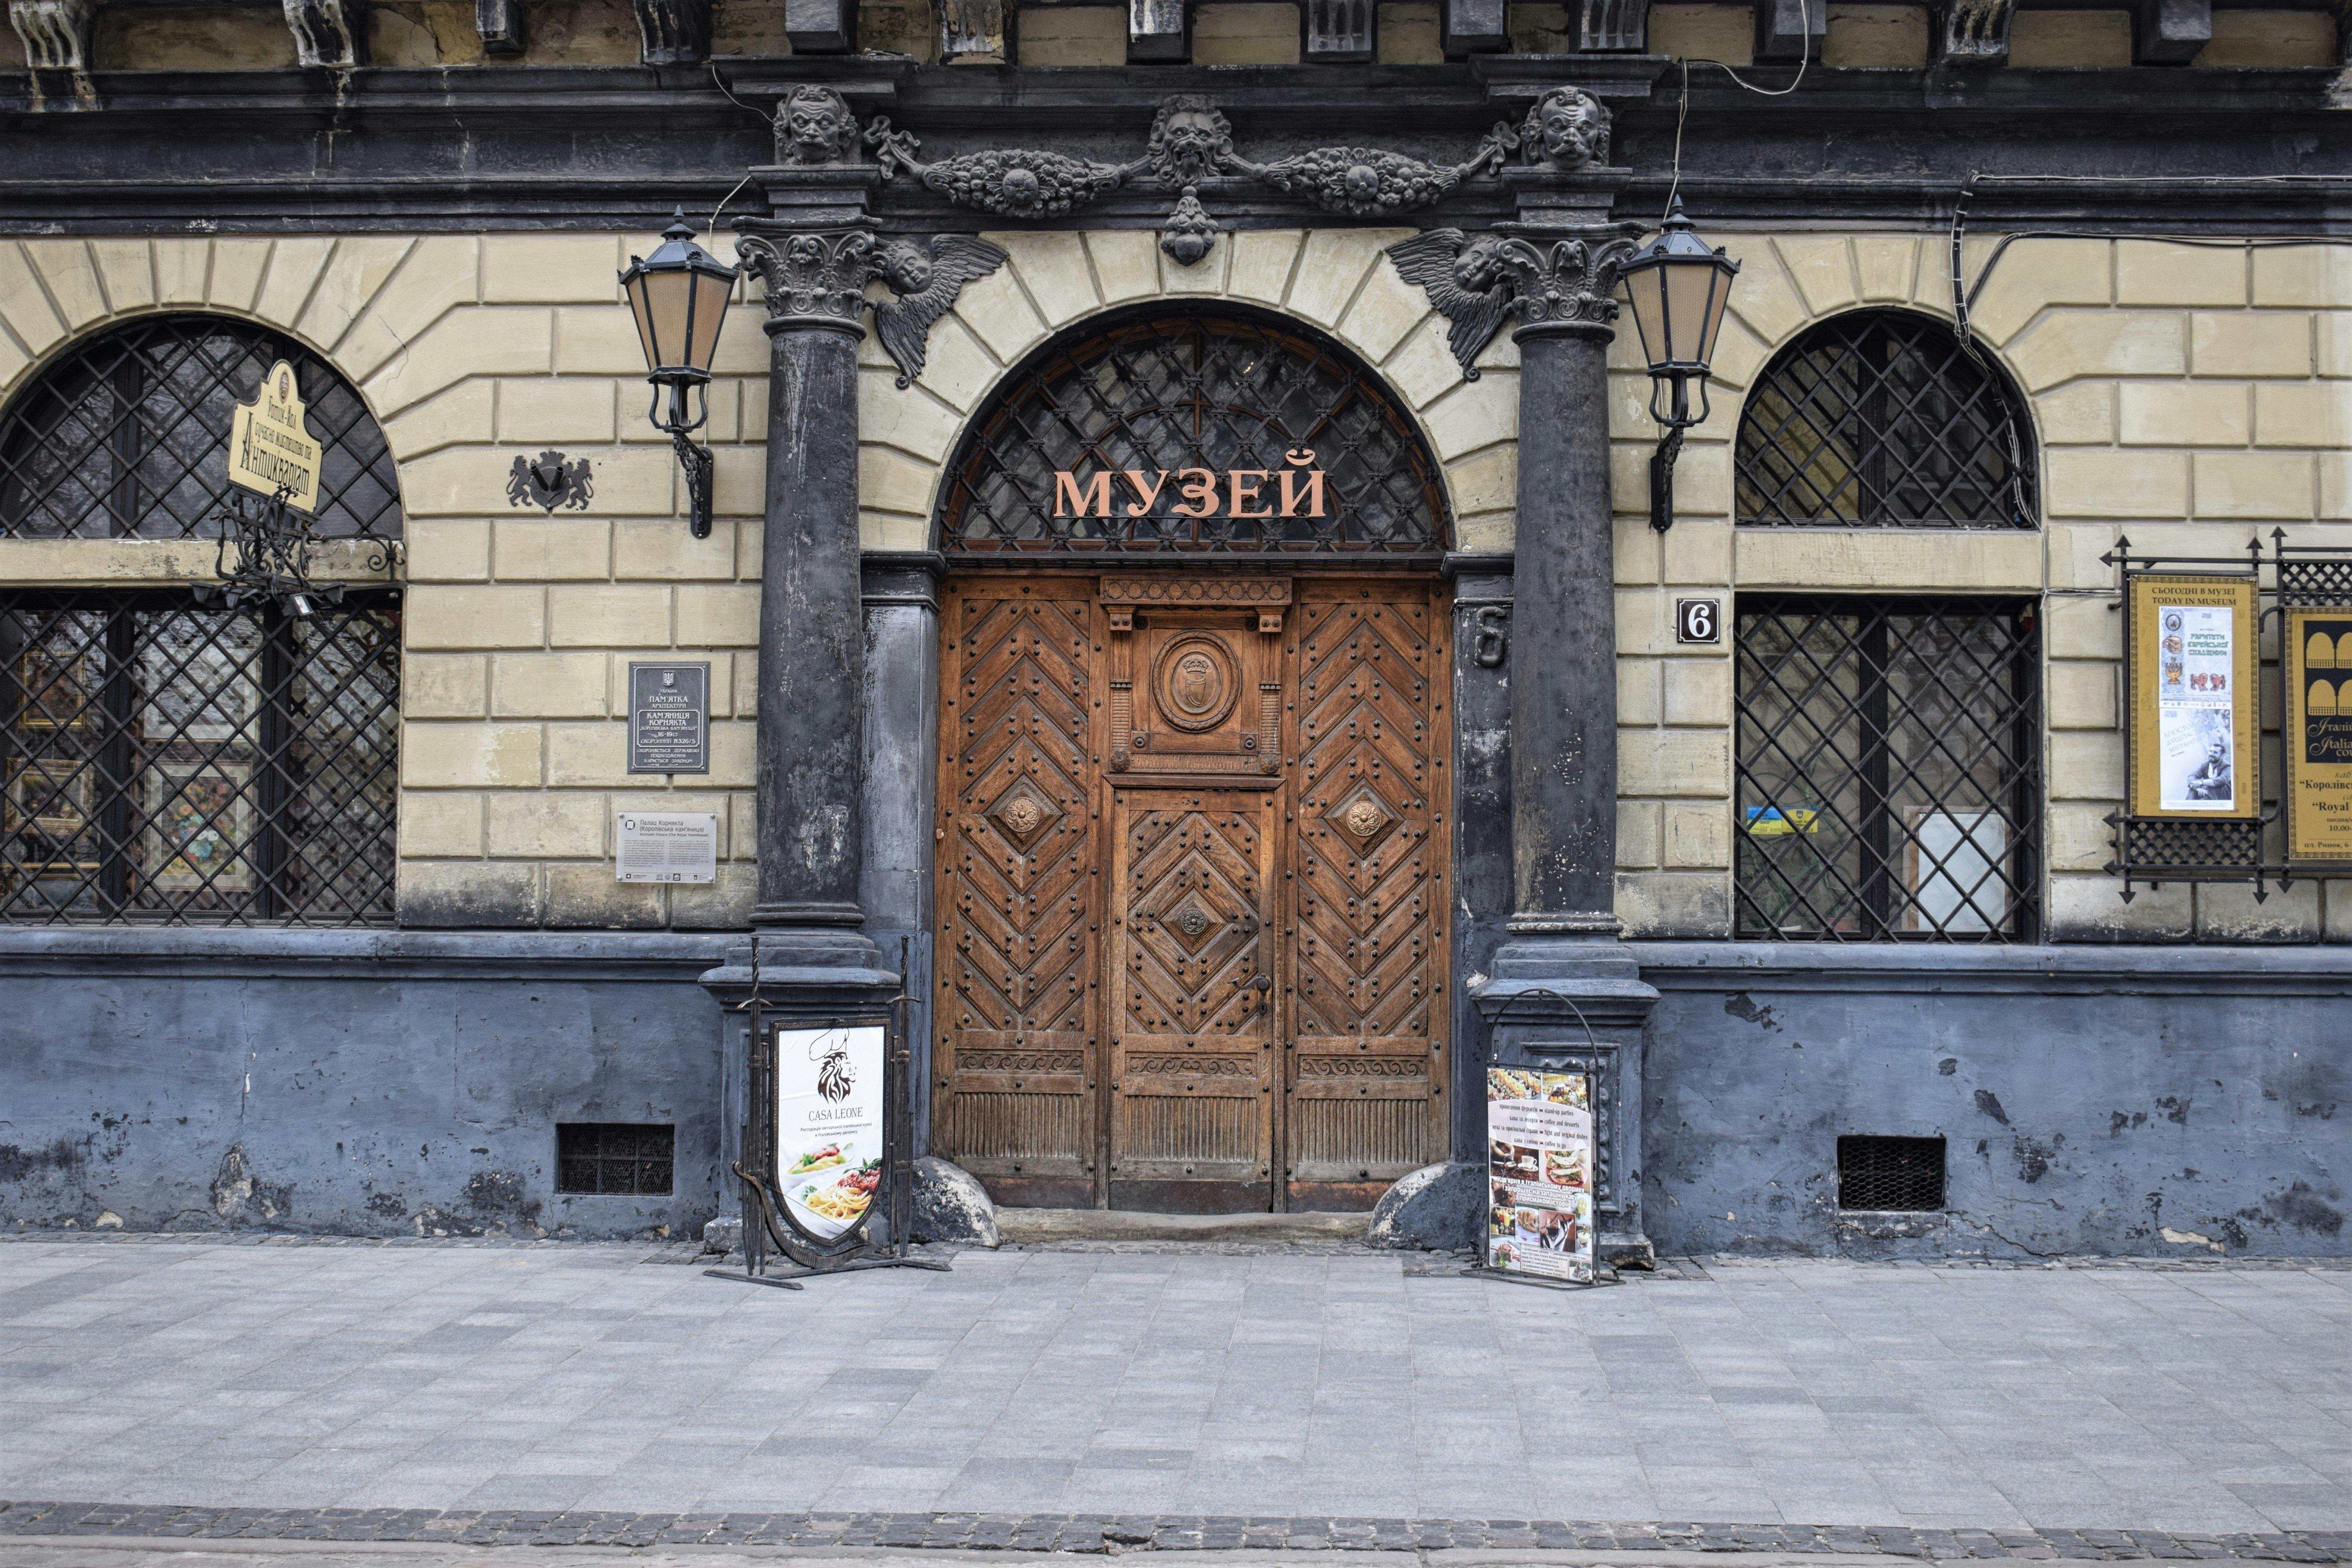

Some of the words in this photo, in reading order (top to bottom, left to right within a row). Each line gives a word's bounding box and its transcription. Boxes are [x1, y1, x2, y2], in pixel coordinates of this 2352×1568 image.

[240, 411, 310, 495] Антикваріат
[1053, 449, 1326, 517] МУЗЕЙ
[2152, 587, 2198, 595] СЬОГОДНІ
[2207, 588, 2235, 596] МУЗЕЇ
[1688, 604, 1711, 637] 6
[809, 1110, 832, 1121] CASA
[835, 1107, 863, 1119] LEONE
[1504, 1186, 1532, 1195] запрошує
[1540, 1190, 1564, 1199] запашну
[1525, 1179, 1561, 1190] Італійському
[1562, 1185, 1584, 1194] дворику
[1519, 1195, 1550, 1205] присмаком
[1551, 1199, 1568, 1207] історії
